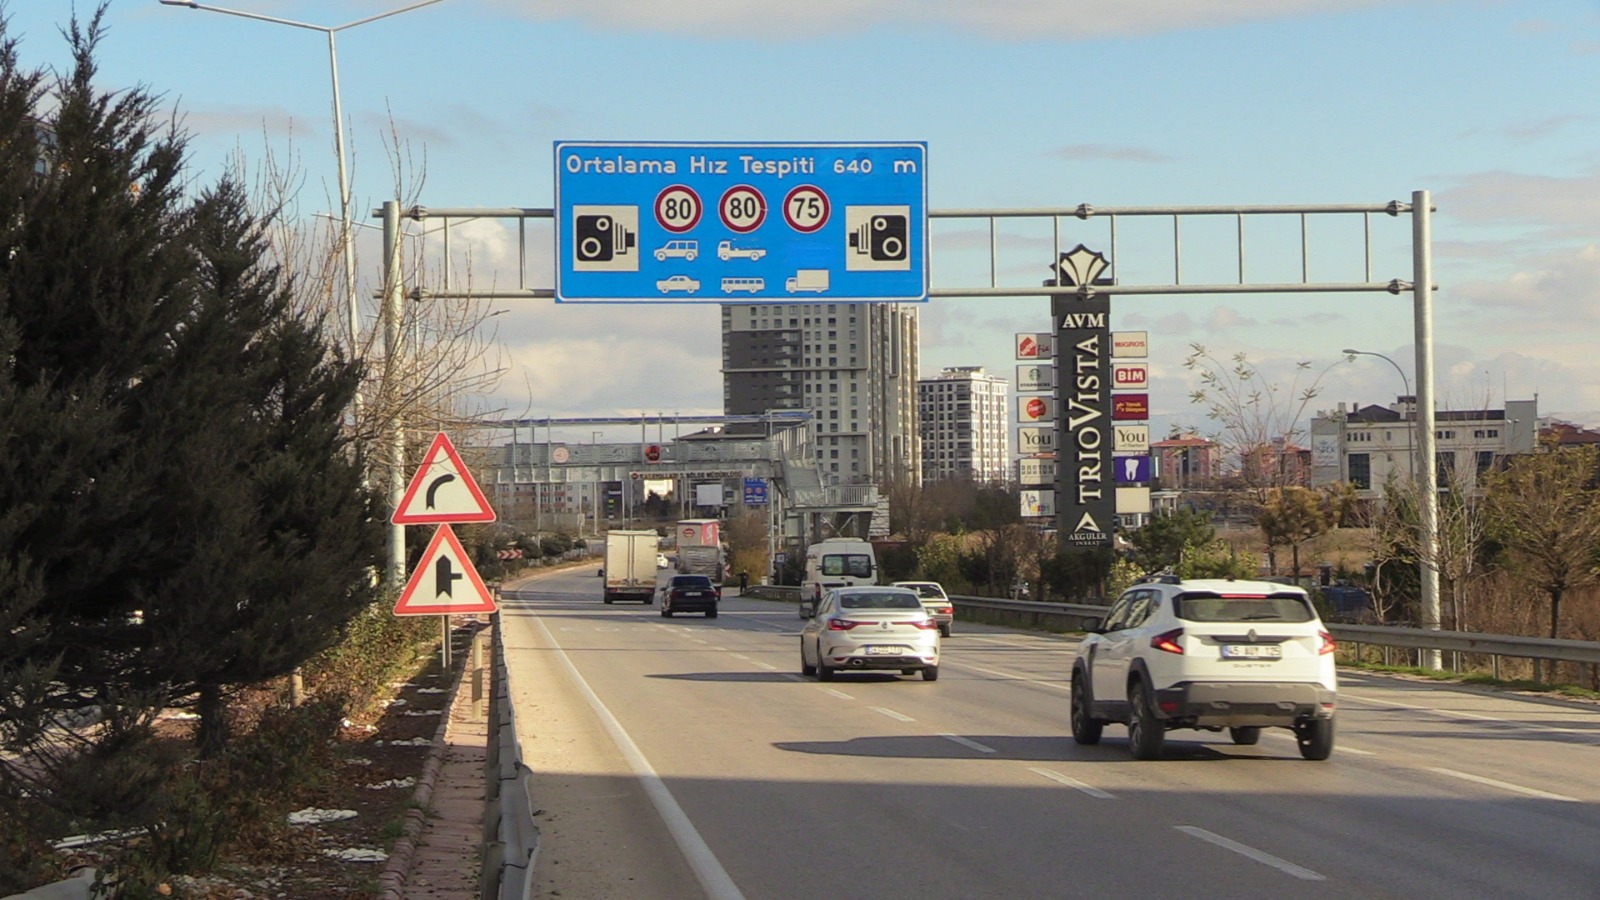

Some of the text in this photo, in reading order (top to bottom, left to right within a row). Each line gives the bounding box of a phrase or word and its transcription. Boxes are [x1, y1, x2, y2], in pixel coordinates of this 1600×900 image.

[566, 154, 917, 179] Ortalama Hız Tespiti 640 m
[665, 198, 692, 220] 80
[730, 197, 756, 220] 80
[793, 197, 820, 220] 75
[1062, 313, 1105, 329] AVM
[1069, 334, 1102, 504] TRIOVISTA
[1022, 431, 1052, 445] You
[1117, 429, 1146, 443] You
